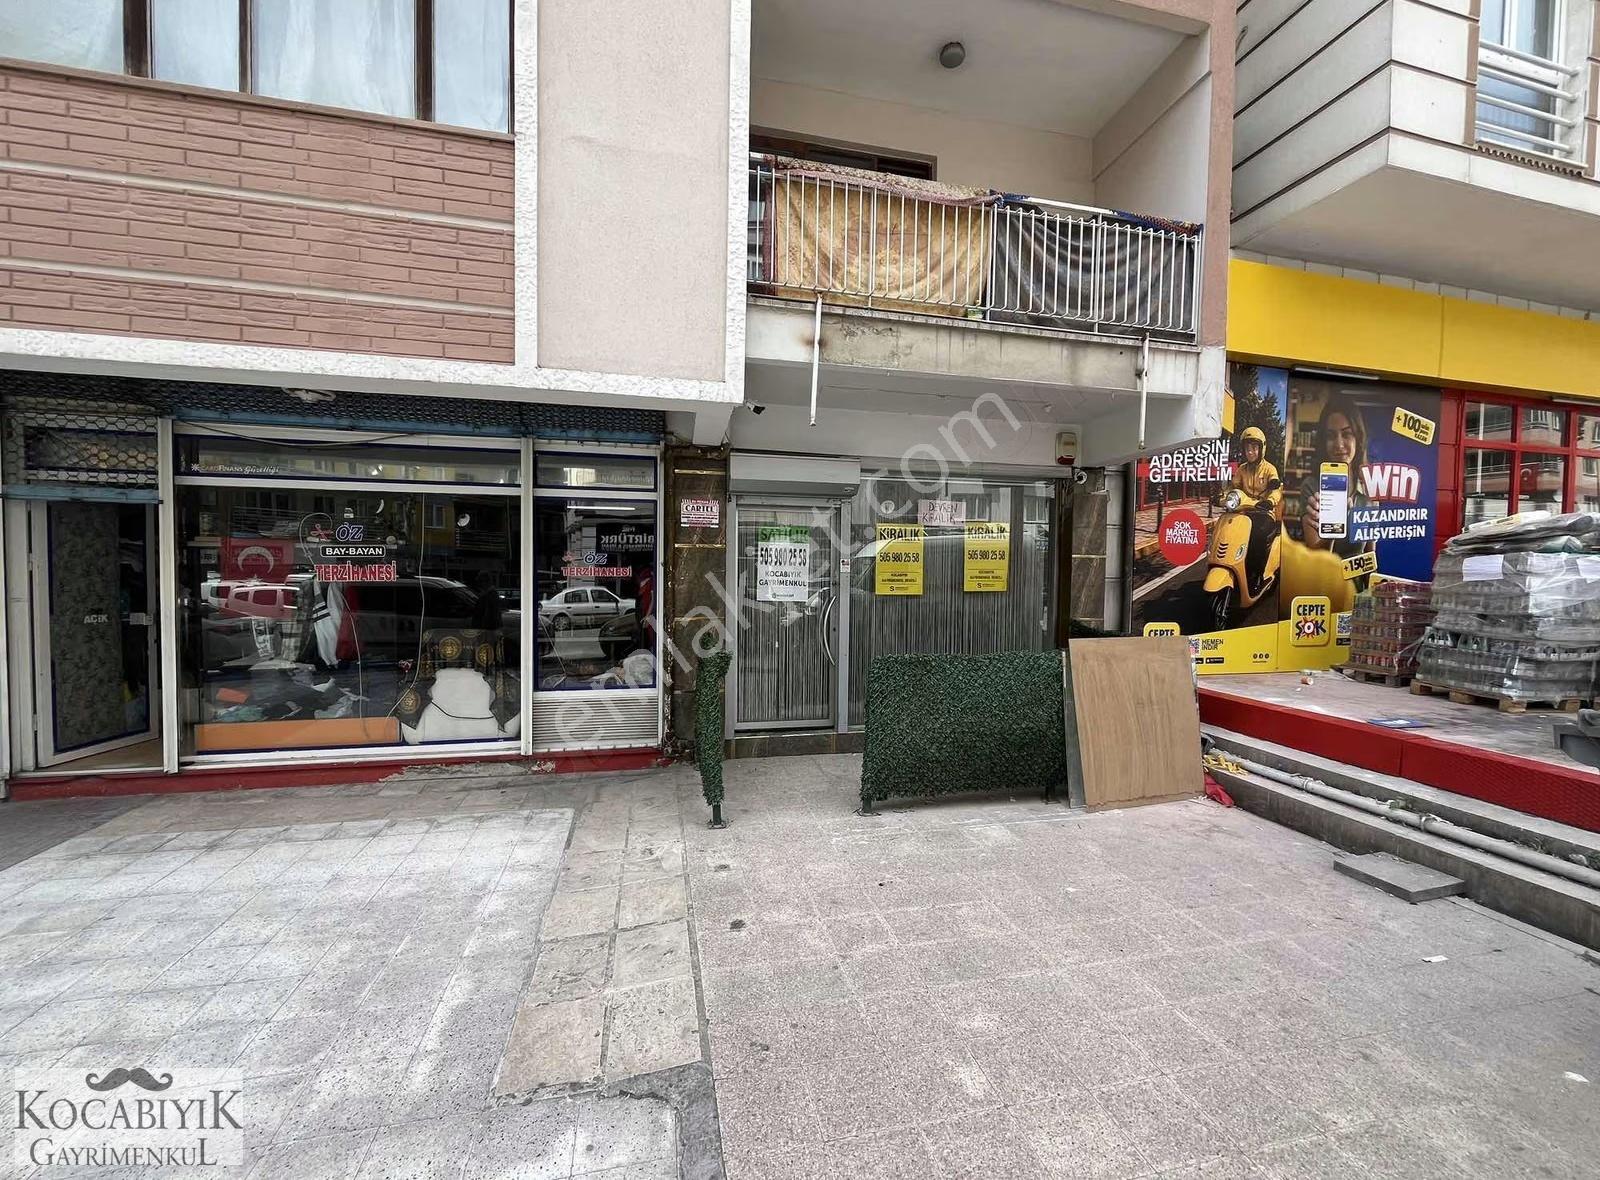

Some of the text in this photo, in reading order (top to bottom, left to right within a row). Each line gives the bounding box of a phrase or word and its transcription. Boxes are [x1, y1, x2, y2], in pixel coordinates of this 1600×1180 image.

[1353, 508, 1428, 523] KAZANDIRIR
[1165, 528, 1199, 537] MARKET
[325, 547, 383, 555] BAY-BAYAN
[759, 547, 773, 566] 505
[774, 547, 788, 567] 980
[798, 548, 807, 567] 58
[879, 551, 891, 563] 505
[891, 551, 903, 563] 980
[911, 552, 920, 563] 58
[967, 549, 979, 560] 505
[979, 549, 990, 560] 980
[998, 550, 1006, 560] 58
[1296, 604, 1326, 616] CEPTE
